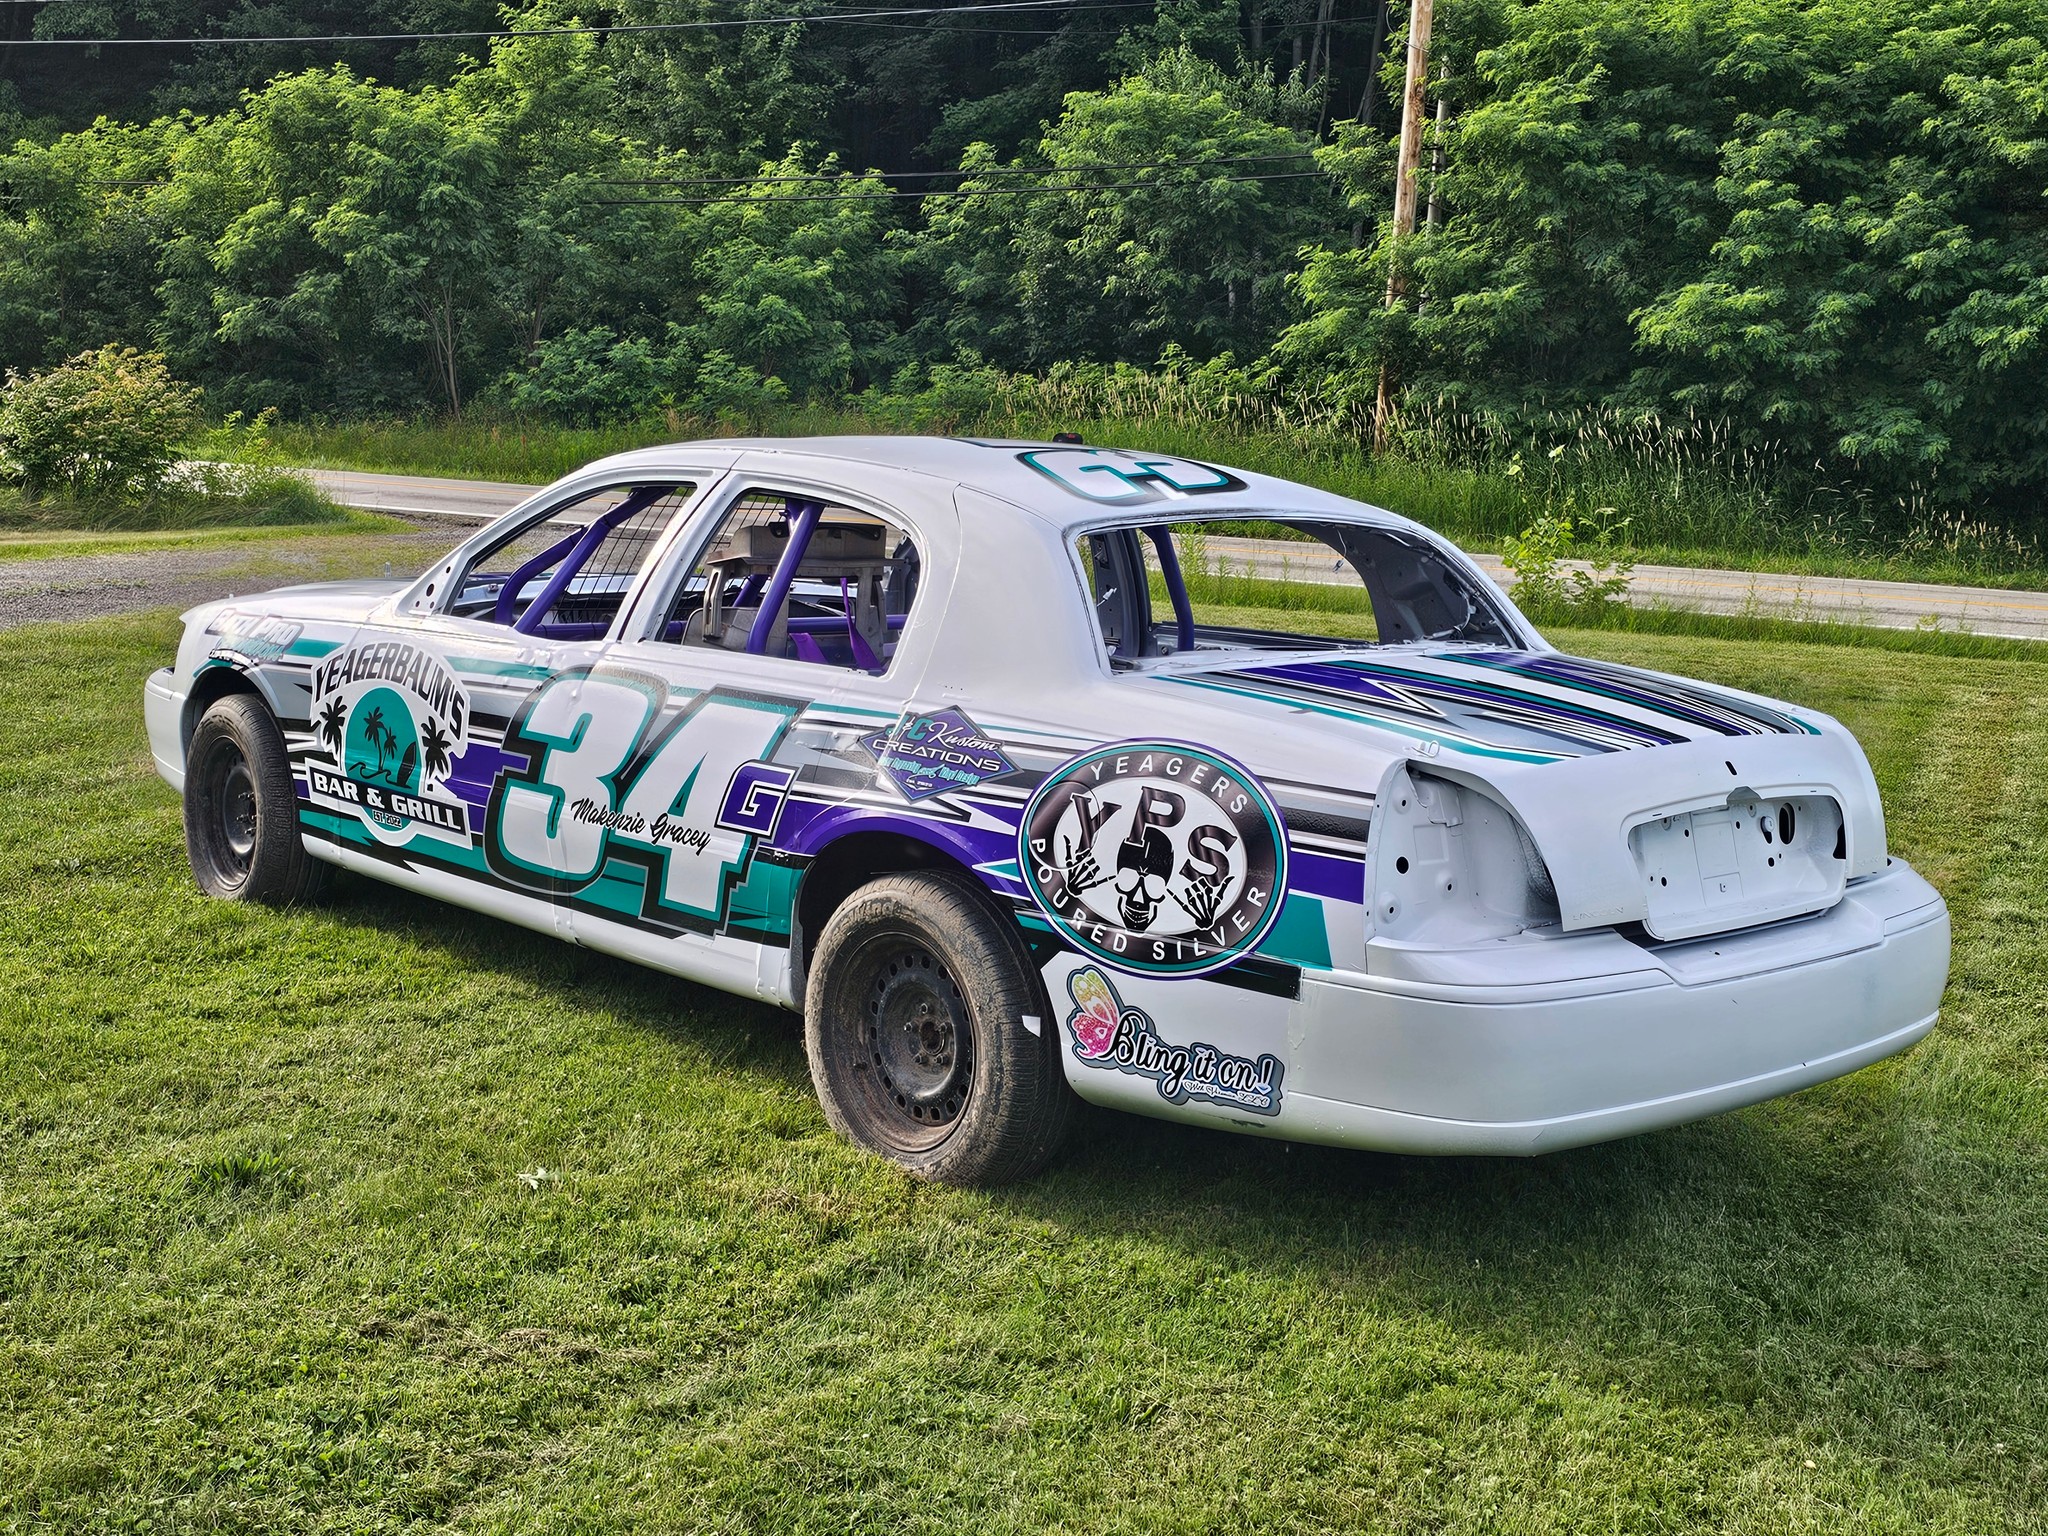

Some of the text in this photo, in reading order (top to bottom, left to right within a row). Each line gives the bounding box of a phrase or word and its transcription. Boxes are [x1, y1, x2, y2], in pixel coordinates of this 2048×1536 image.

[247, 615, 302, 646] PRO
[315, 642, 465, 741] YEAGERBAUM'S
[871, 738, 1002, 773] CREATIONS
[927, 721, 1002, 750] Kustom
[313, 771, 462, 831] BAR & GRILL
[497, 672, 802, 922] 34 G
[1090, 754, 1248, 814] YEAGERS
[570, 797, 712, 857] Makenzie Gracey
[1031, 838, 1128, 953] POURED
[1152, 886, 1267, 961] SILVER
[1097, 1010, 1276, 1099] Bling it on!
